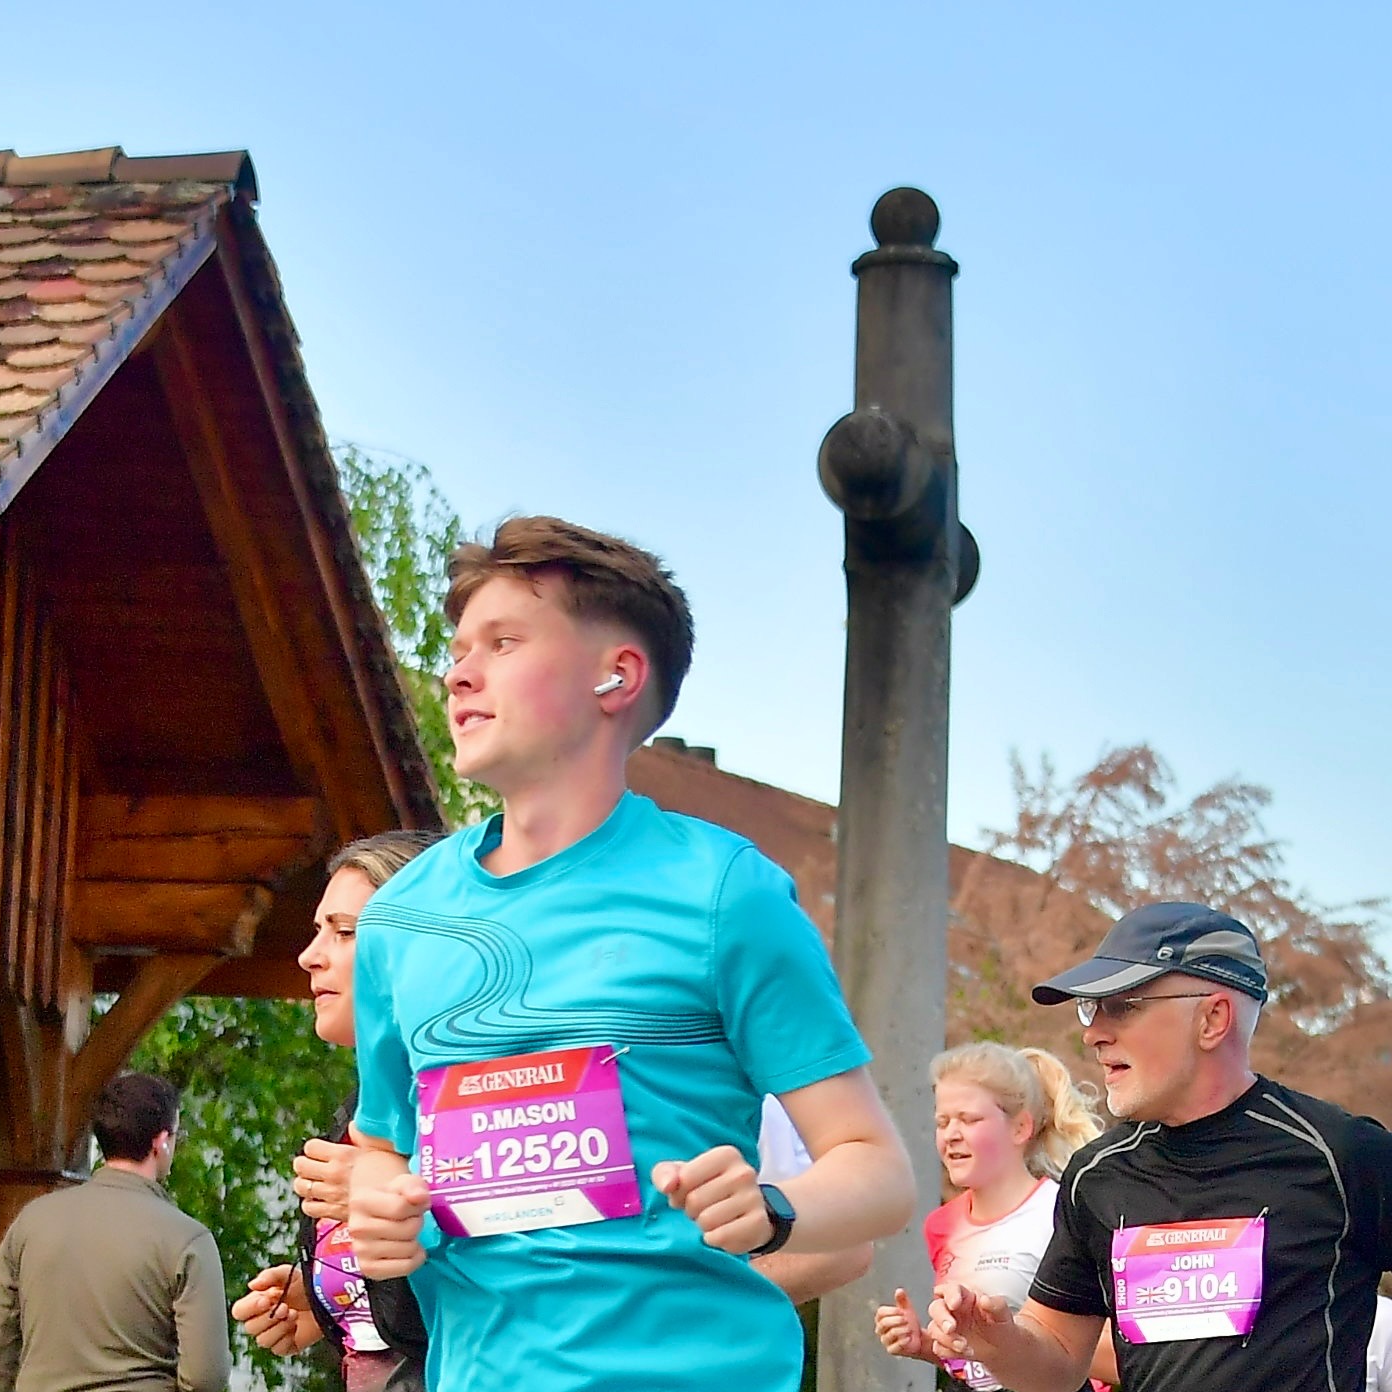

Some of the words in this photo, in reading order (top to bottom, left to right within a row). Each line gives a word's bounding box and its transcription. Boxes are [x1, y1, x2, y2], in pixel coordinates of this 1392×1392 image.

[482, 1063, 565, 1092] GENERALI
[471, 1100, 576, 1133] D.MASON
[473, 1127, 609, 1179] 12520
[1165, 1228, 1228, 1245] GENERALI
[1171, 1254, 1215, 1271] JOHN
[1163, 1271, 1238, 1303] 9104
